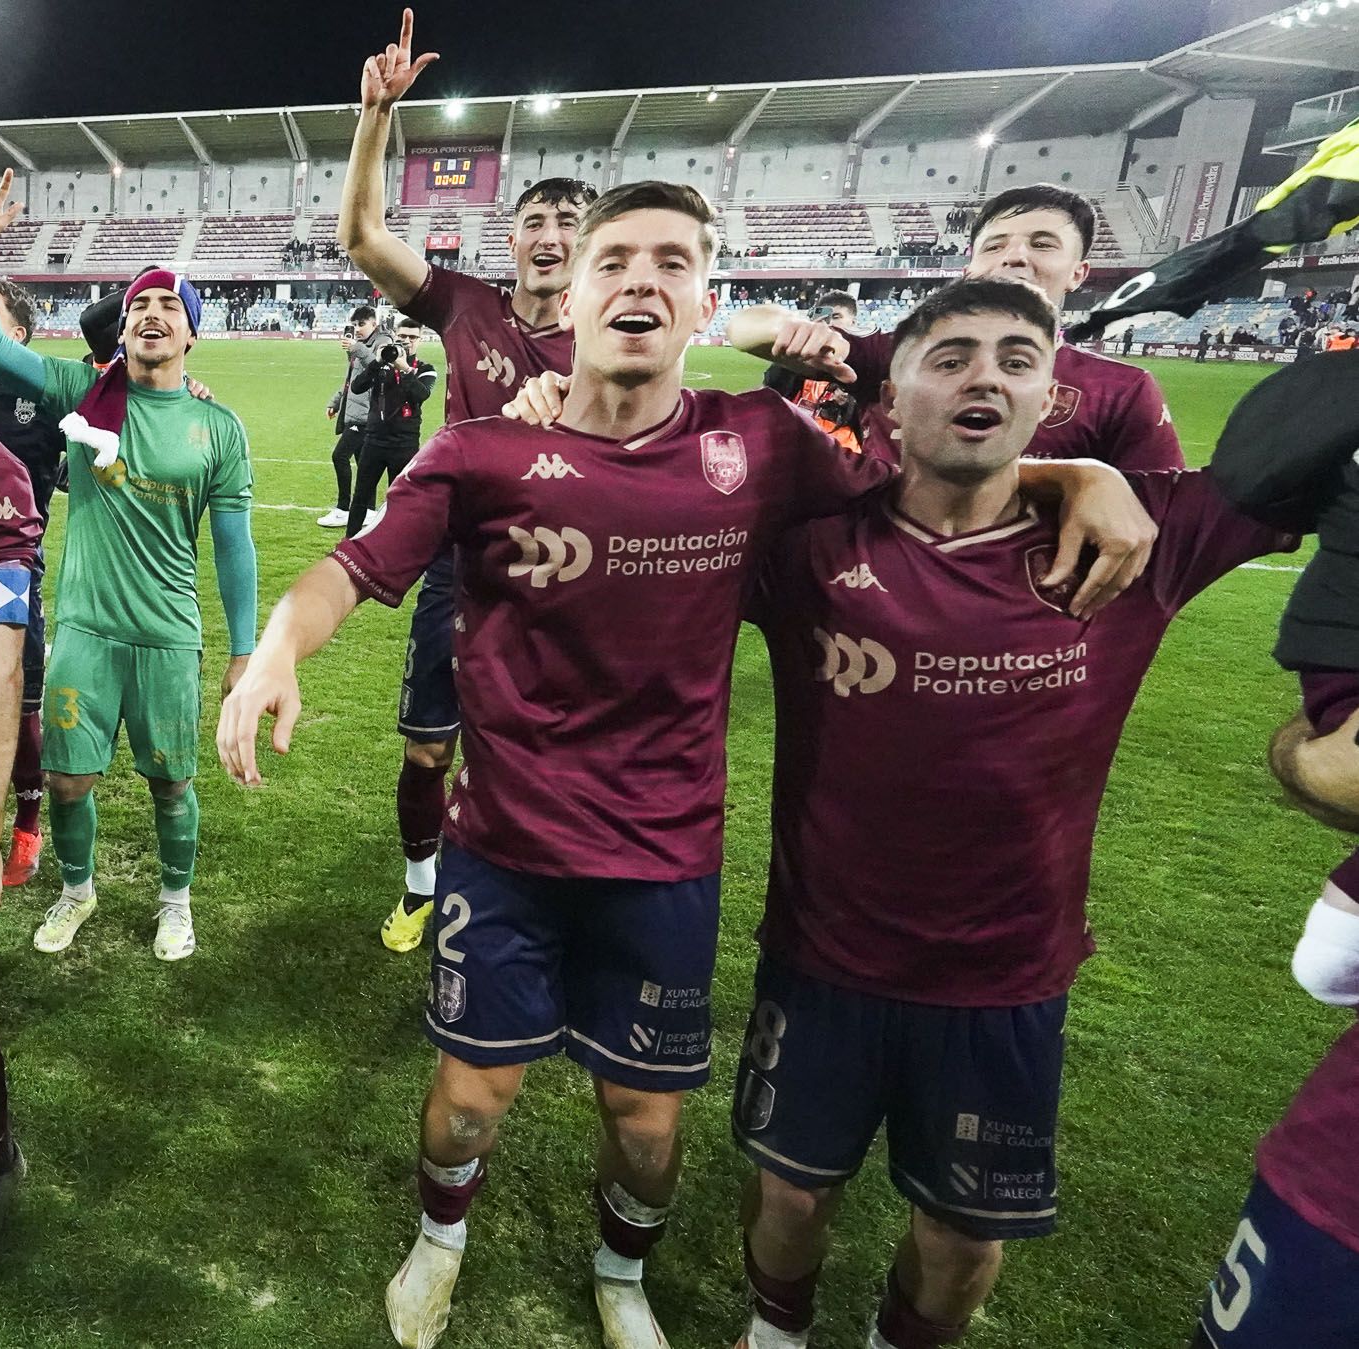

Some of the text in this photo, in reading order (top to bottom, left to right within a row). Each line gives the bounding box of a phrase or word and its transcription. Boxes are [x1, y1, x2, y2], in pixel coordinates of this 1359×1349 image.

[440, 145, 495, 153] PONTEVEDRA
[433, 160, 471, 172] 0 0
[608, 526, 748, 558] Deputación
[606, 550, 743, 576] Pontevedra
[914, 642, 1087, 678] Deputación
[912, 665, 1087, 695] Pontevedra
[437, 892, 472, 964] 2
[665, 987, 701, 999] XUNTA
[666, 1030, 706, 1043] DEPORT
[1208, 1217, 1267, 1332] 5
